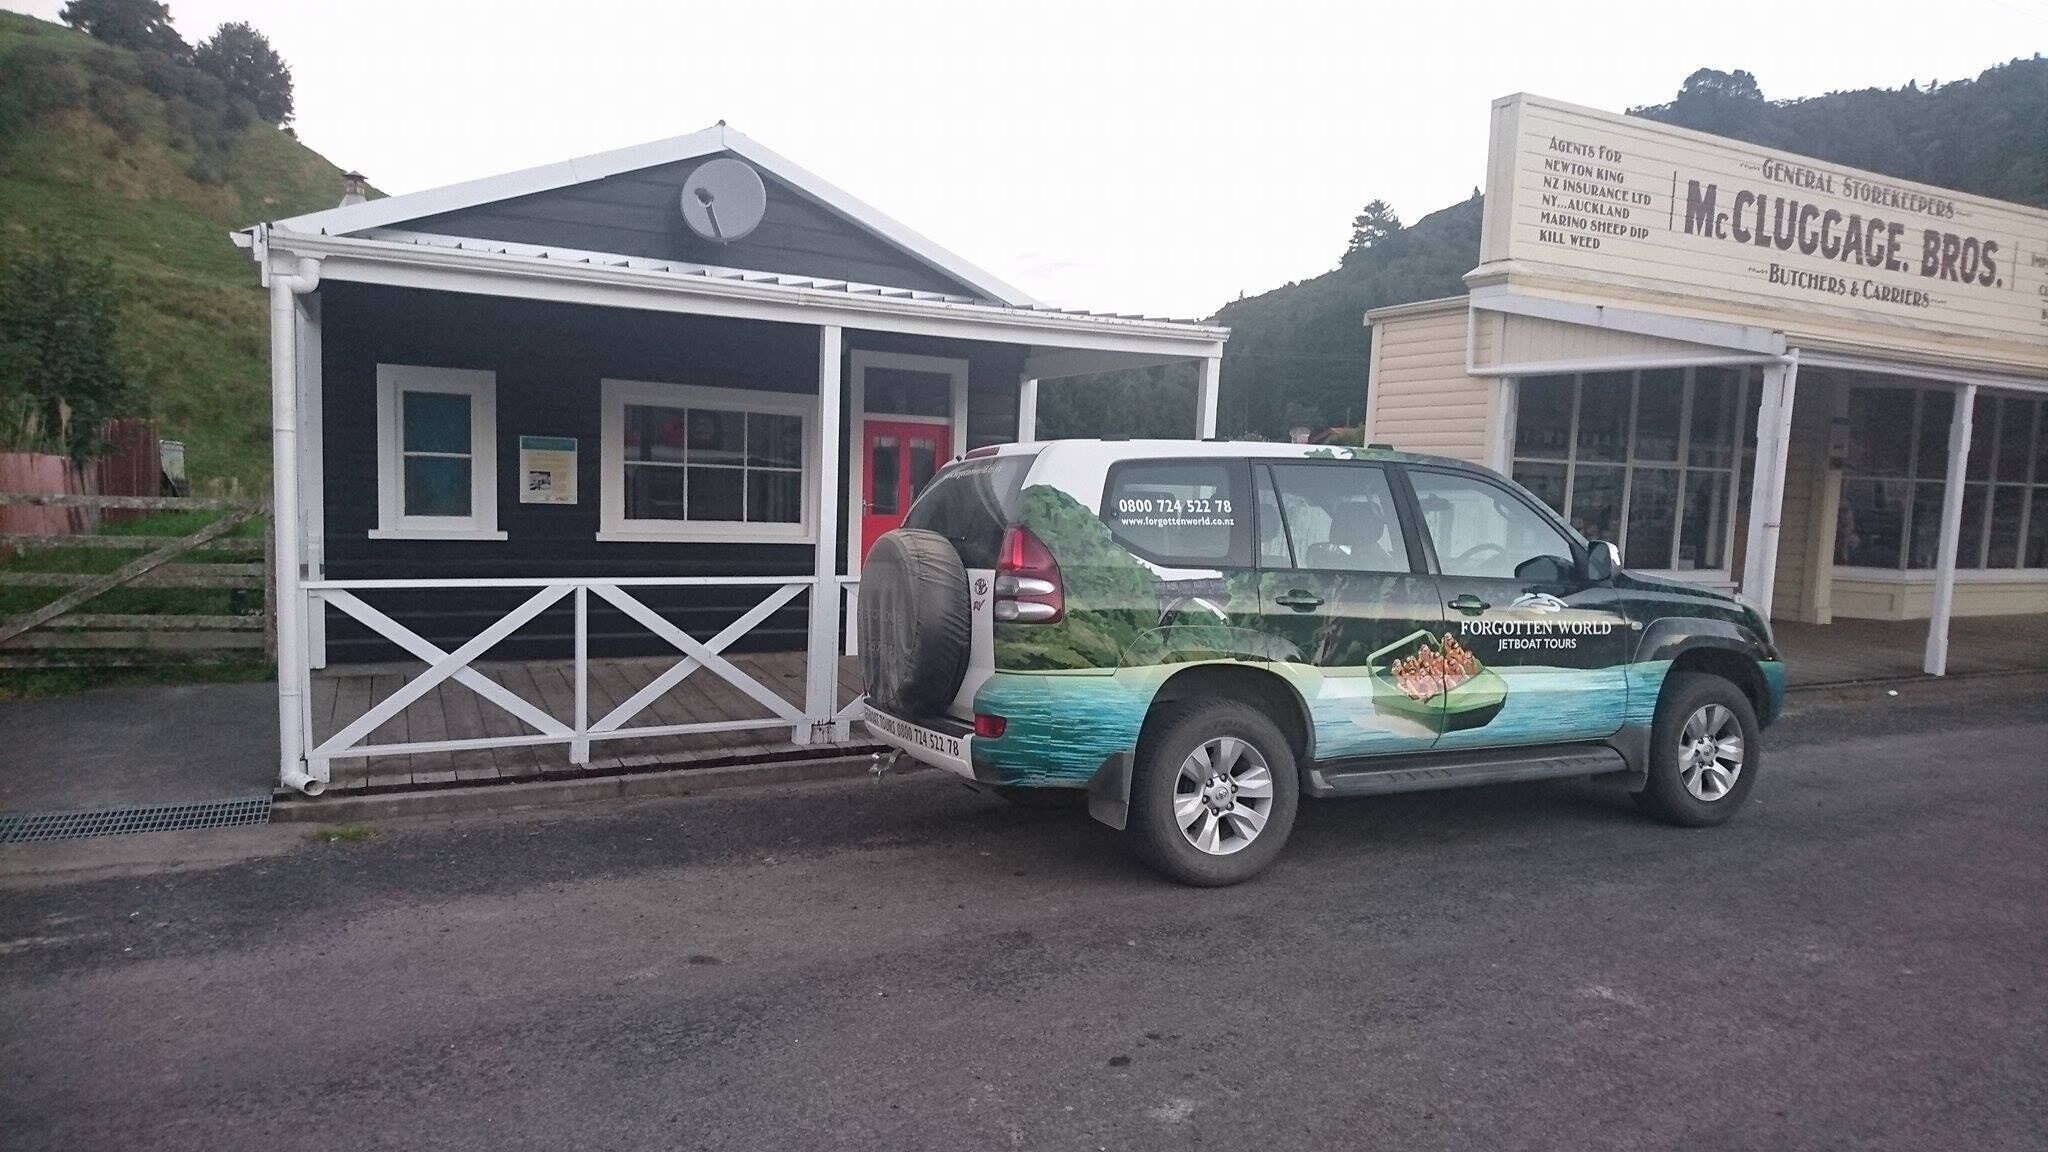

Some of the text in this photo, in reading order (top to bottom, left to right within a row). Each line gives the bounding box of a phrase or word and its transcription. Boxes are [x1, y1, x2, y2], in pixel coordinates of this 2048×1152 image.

[1549, 136, 1622, 163] AGENTS FOR
[1544, 158, 1625, 185] NEWTON KING
[1543, 176, 1652, 206] NZ INSURANCE LTD
[1762, 158, 1955, 220] GENERAL STOREKEEPERS
[1539, 229, 1601, 249] KILL WEED
[1540, 211, 1649, 240] MARINO SHEEP DIP
[1920, 229, 2003, 289] BROS.
[1769, 262, 1930, 308] BUTCHERS & CARRIERS
[1119, 499, 1232, 513] 0800 724 522 78
[1121, 516, 1235, 528] www.forgottenworld.co.nz
[1460, 620, 1612, 635] FORGOTTEN WORLD
[1498, 638, 1577, 651] JETBOAT TOURS
[897, 723, 913, 742] 0800
[914, 729, 928, 747] 724
[929, 734, 945, 753] 522
[947, 739, 960, 756] 78
